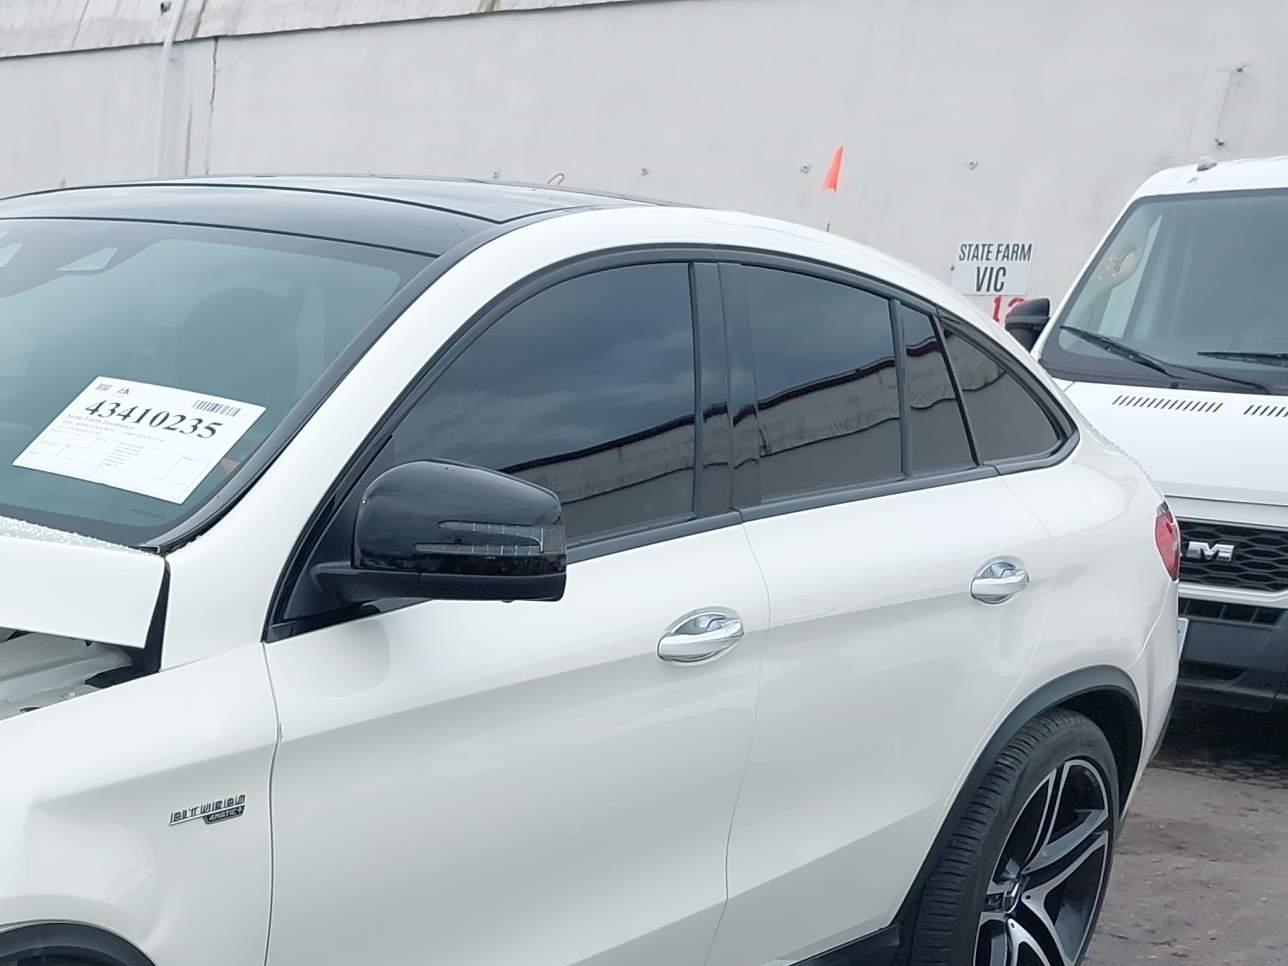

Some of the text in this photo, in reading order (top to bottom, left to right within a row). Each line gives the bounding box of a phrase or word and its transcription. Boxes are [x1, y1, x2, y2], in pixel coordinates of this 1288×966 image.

[959, 243, 1032, 261] STATE FARM
[976, 266, 1007, 293] VIC
[85, 400, 225, 440] 43410235
